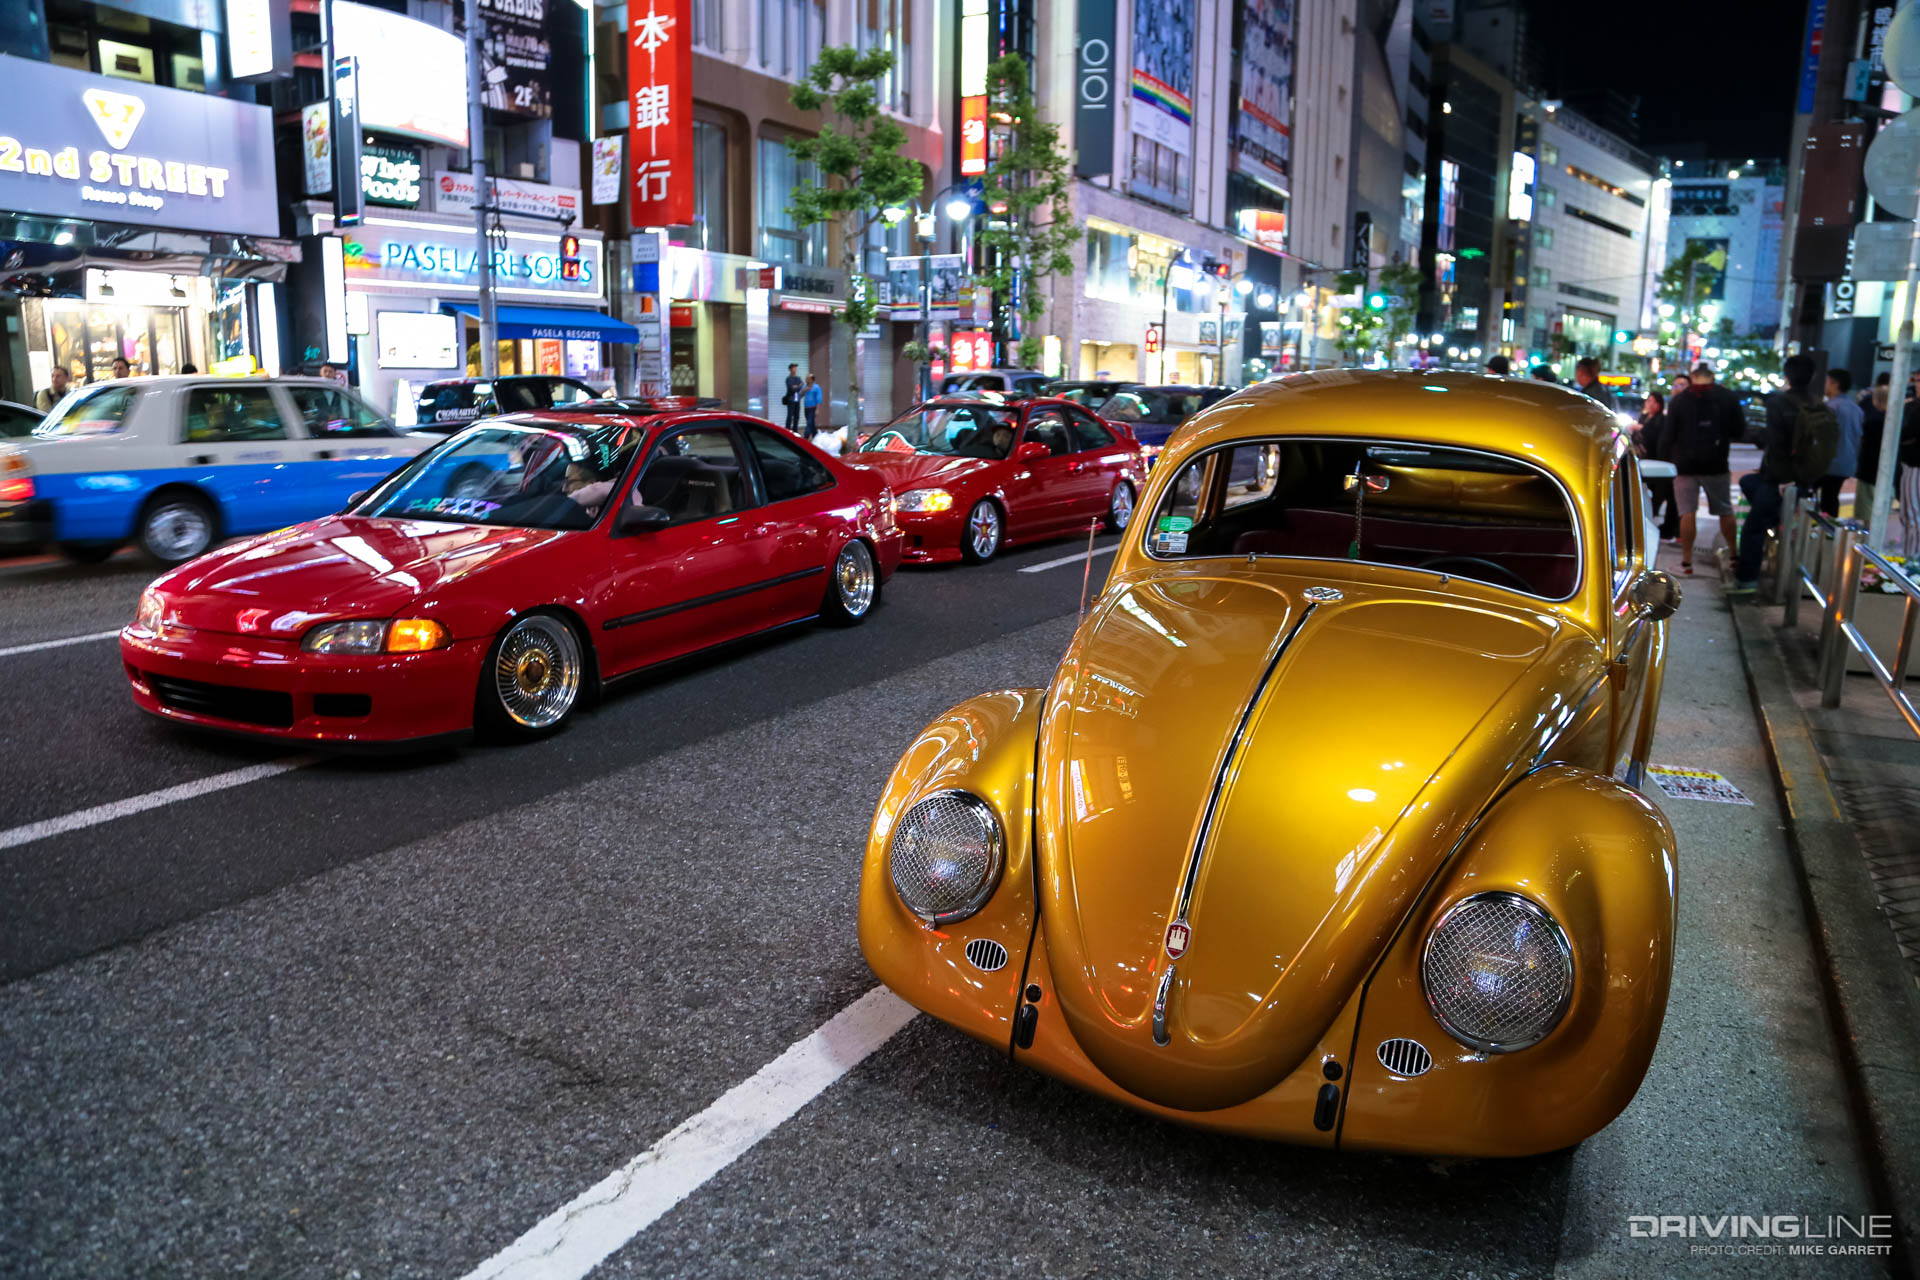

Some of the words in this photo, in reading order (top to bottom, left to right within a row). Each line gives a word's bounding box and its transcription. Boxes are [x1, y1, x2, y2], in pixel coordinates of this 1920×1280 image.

[514, 85, 533, 106] 2F
[634, 11, 672, 202] 本銀行
[0, 137, 81, 180] 2nd
[89, 150, 230, 198] STREET
[128, 191, 164, 210] Shop
[387, 242, 480, 273] PASELA
[494, 251, 592, 282] RESORS
[532, 328, 563, 338] PASELA
[566, 330, 601, 340] RESORTS
